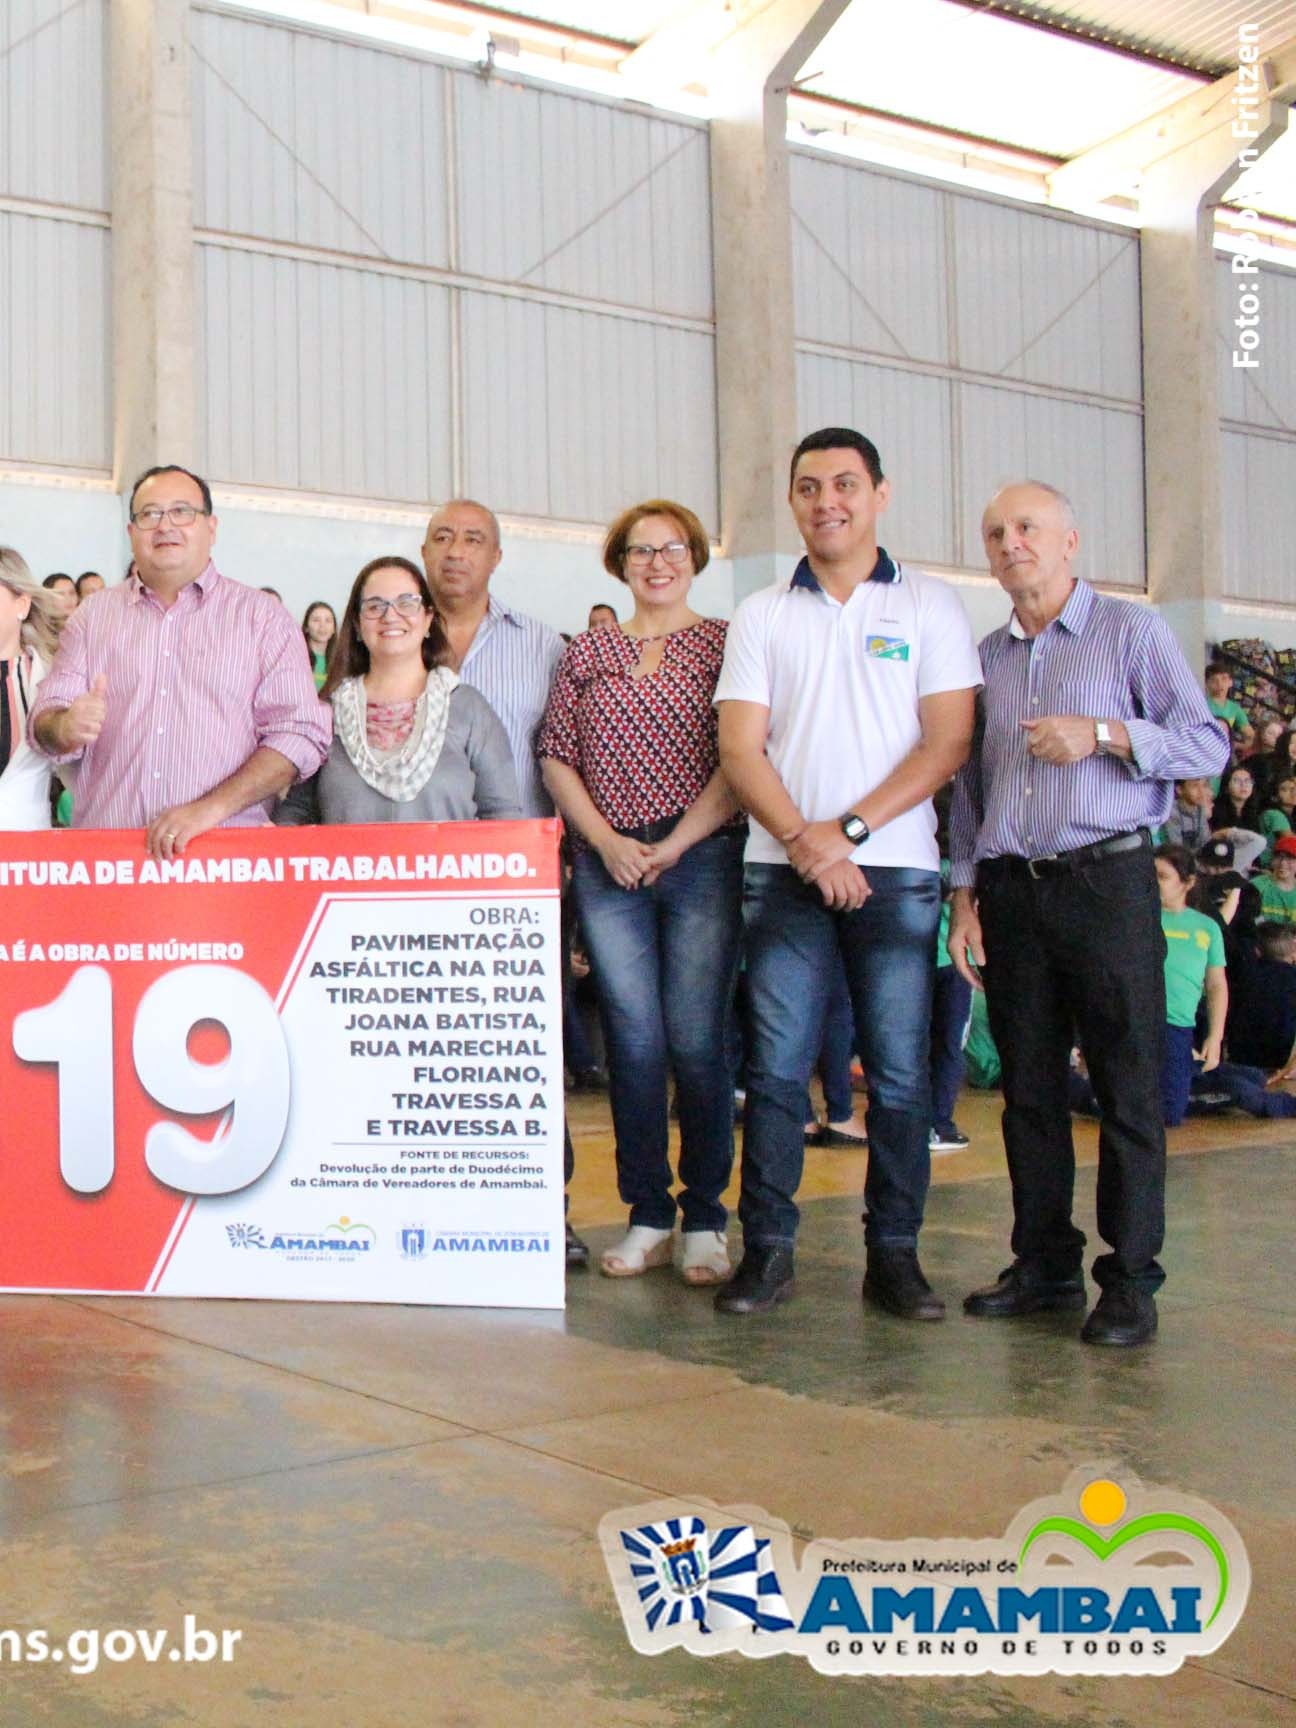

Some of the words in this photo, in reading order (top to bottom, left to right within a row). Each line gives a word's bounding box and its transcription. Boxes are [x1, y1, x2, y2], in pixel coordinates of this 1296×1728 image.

[95, 860, 134, 884] DE
[139, 858, 284, 883] AMAMBAI
[289, 852, 537, 881] TRABALHANDO.
[470, 908, 538, 924] OBRA:
[352, 928, 544, 952] PAVIMENTAÇÃO
[11, 939, 27, 961] É
[29, 945, 47, 961] A
[49, 944, 111, 961] OBRA
[115, 943, 144, 960] DE
[147, 939, 244, 960] NÚMERO
[310, 958, 442, 977] ASFÁLTICA
[451, 961, 485, 976] NA
[494, 960, 544, 976] RUA
[326, 987, 486, 1005] TIRADENTES,
[494, 987, 544, 1002] RUA
[345, 1014, 429, 1030] JOANA
[437, 1013, 545, 1032] BATISTA,
[351, 1041, 400, 1056] RUA
[409, 1040, 546, 1056] MARECHAL
[414, 1067, 546, 1085] FLORIANO,
[392, 1093, 521, 1109] TRAVESSA
[530, 1093, 546, 1109] A
[367, 1120, 381, 1135] E
[388, 1120, 517, 1136] TRAVESSA
[525, 1120, 547, 1136] B.
[400, 1151, 439, 1159] FONTE
[443, 1151, 458, 1160] DE
[461, 1151, 529, 1160] RECURSOS:
[319, 1163, 388, 1174] Devolução
[390, 1164, 407, 1174] de
[410, 1165, 445, 1175] parte
[448, 1165, 465, 1174] de
[468, 1164, 544, 1174] Duodécimo
[290, 1177, 307, 1187] da
[309, 1177, 360, 1188] Câmara
[362, 1178, 379, 1188] de
[382, 1178, 457, 1189] Vereadores
[459, 1179, 476, 1189] de
[479, 1179, 547, 1189] Amambai.
[271, 1237, 369, 1250] AMAMBAI
[433, 1238, 550, 1252] AMAMBAI
